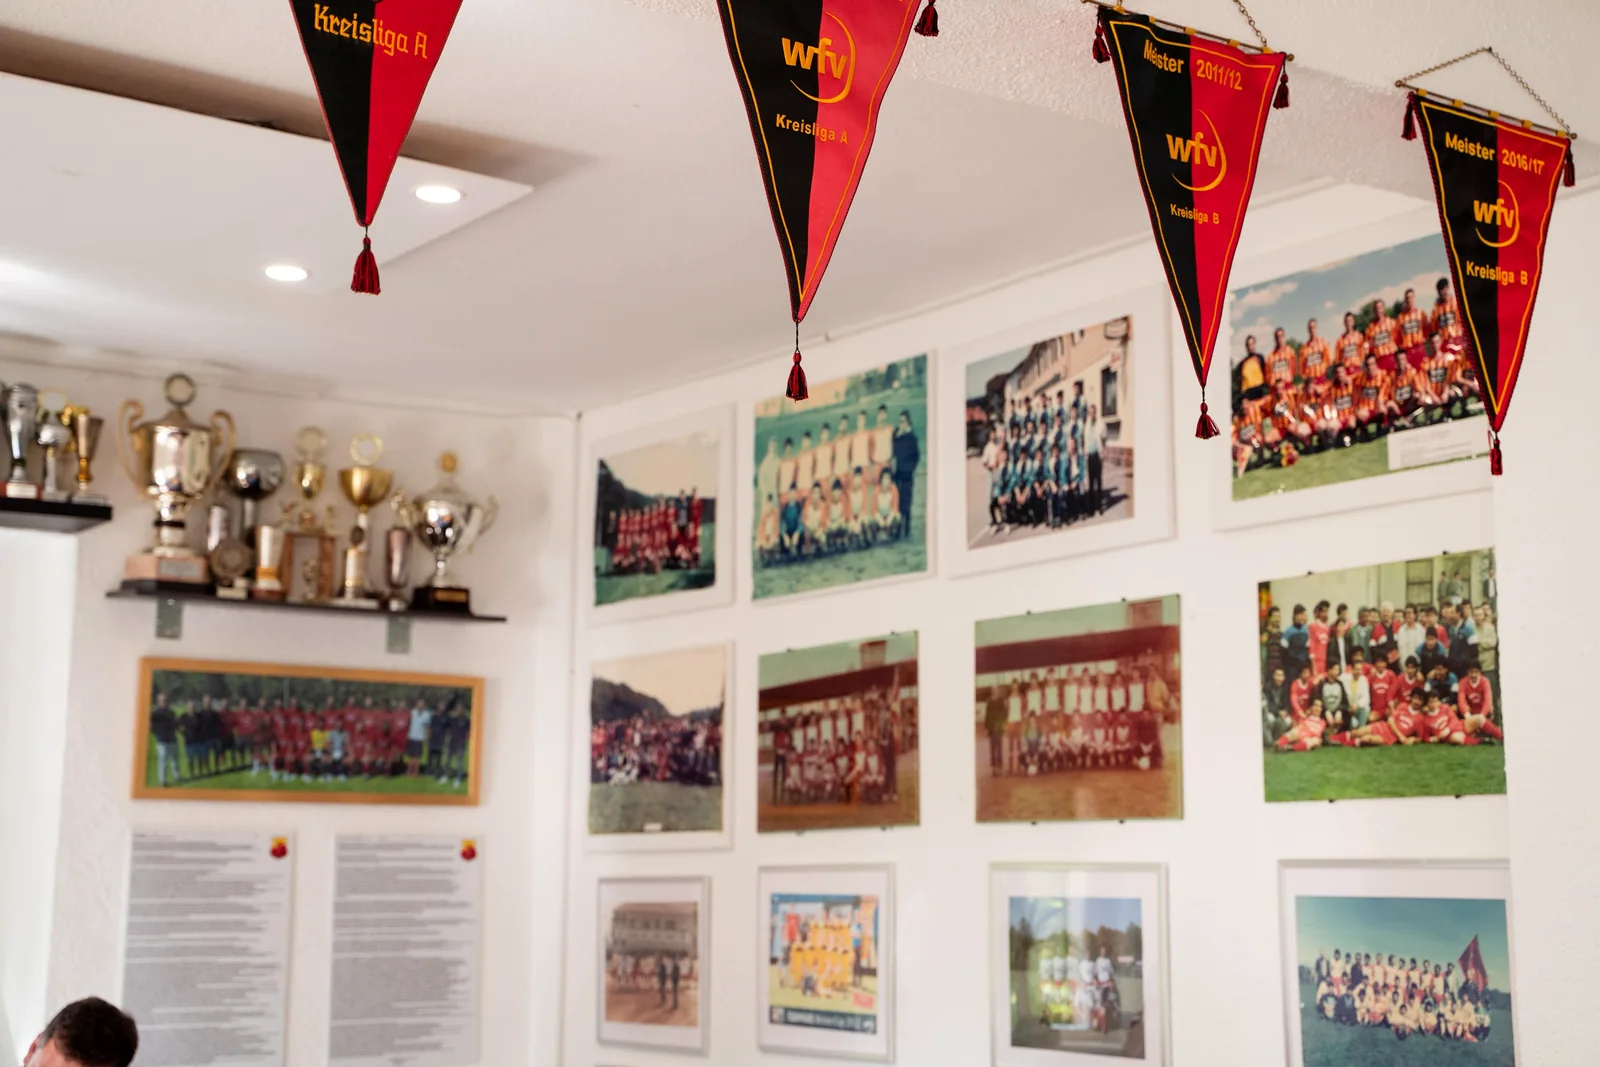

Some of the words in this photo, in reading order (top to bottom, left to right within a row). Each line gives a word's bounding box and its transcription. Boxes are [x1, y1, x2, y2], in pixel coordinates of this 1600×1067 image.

[314, 3, 409, 57] Kreisliga
[414, 31, 428, 59] A
[781, 37, 848, 80] wfv
[1143, 39, 1185, 74] Meister
[1196, 59, 1243, 91] 2011/12
[775, 113, 836, 142] Kreisliga
[839, 130, 848, 144] A
[1166, 132, 1217, 168] wfv
[1445, 132, 1495, 161] Meister
[1501, 148, 1545, 175] 2016/17
[1170, 203, 1209, 225] Kreisliga
[1212, 212, 1220, 225] B
[1473, 198, 1515, 228] wfv
[1466, 260, 1515, 286] Kreisliga
[1520, 270, 1528, 285] B
